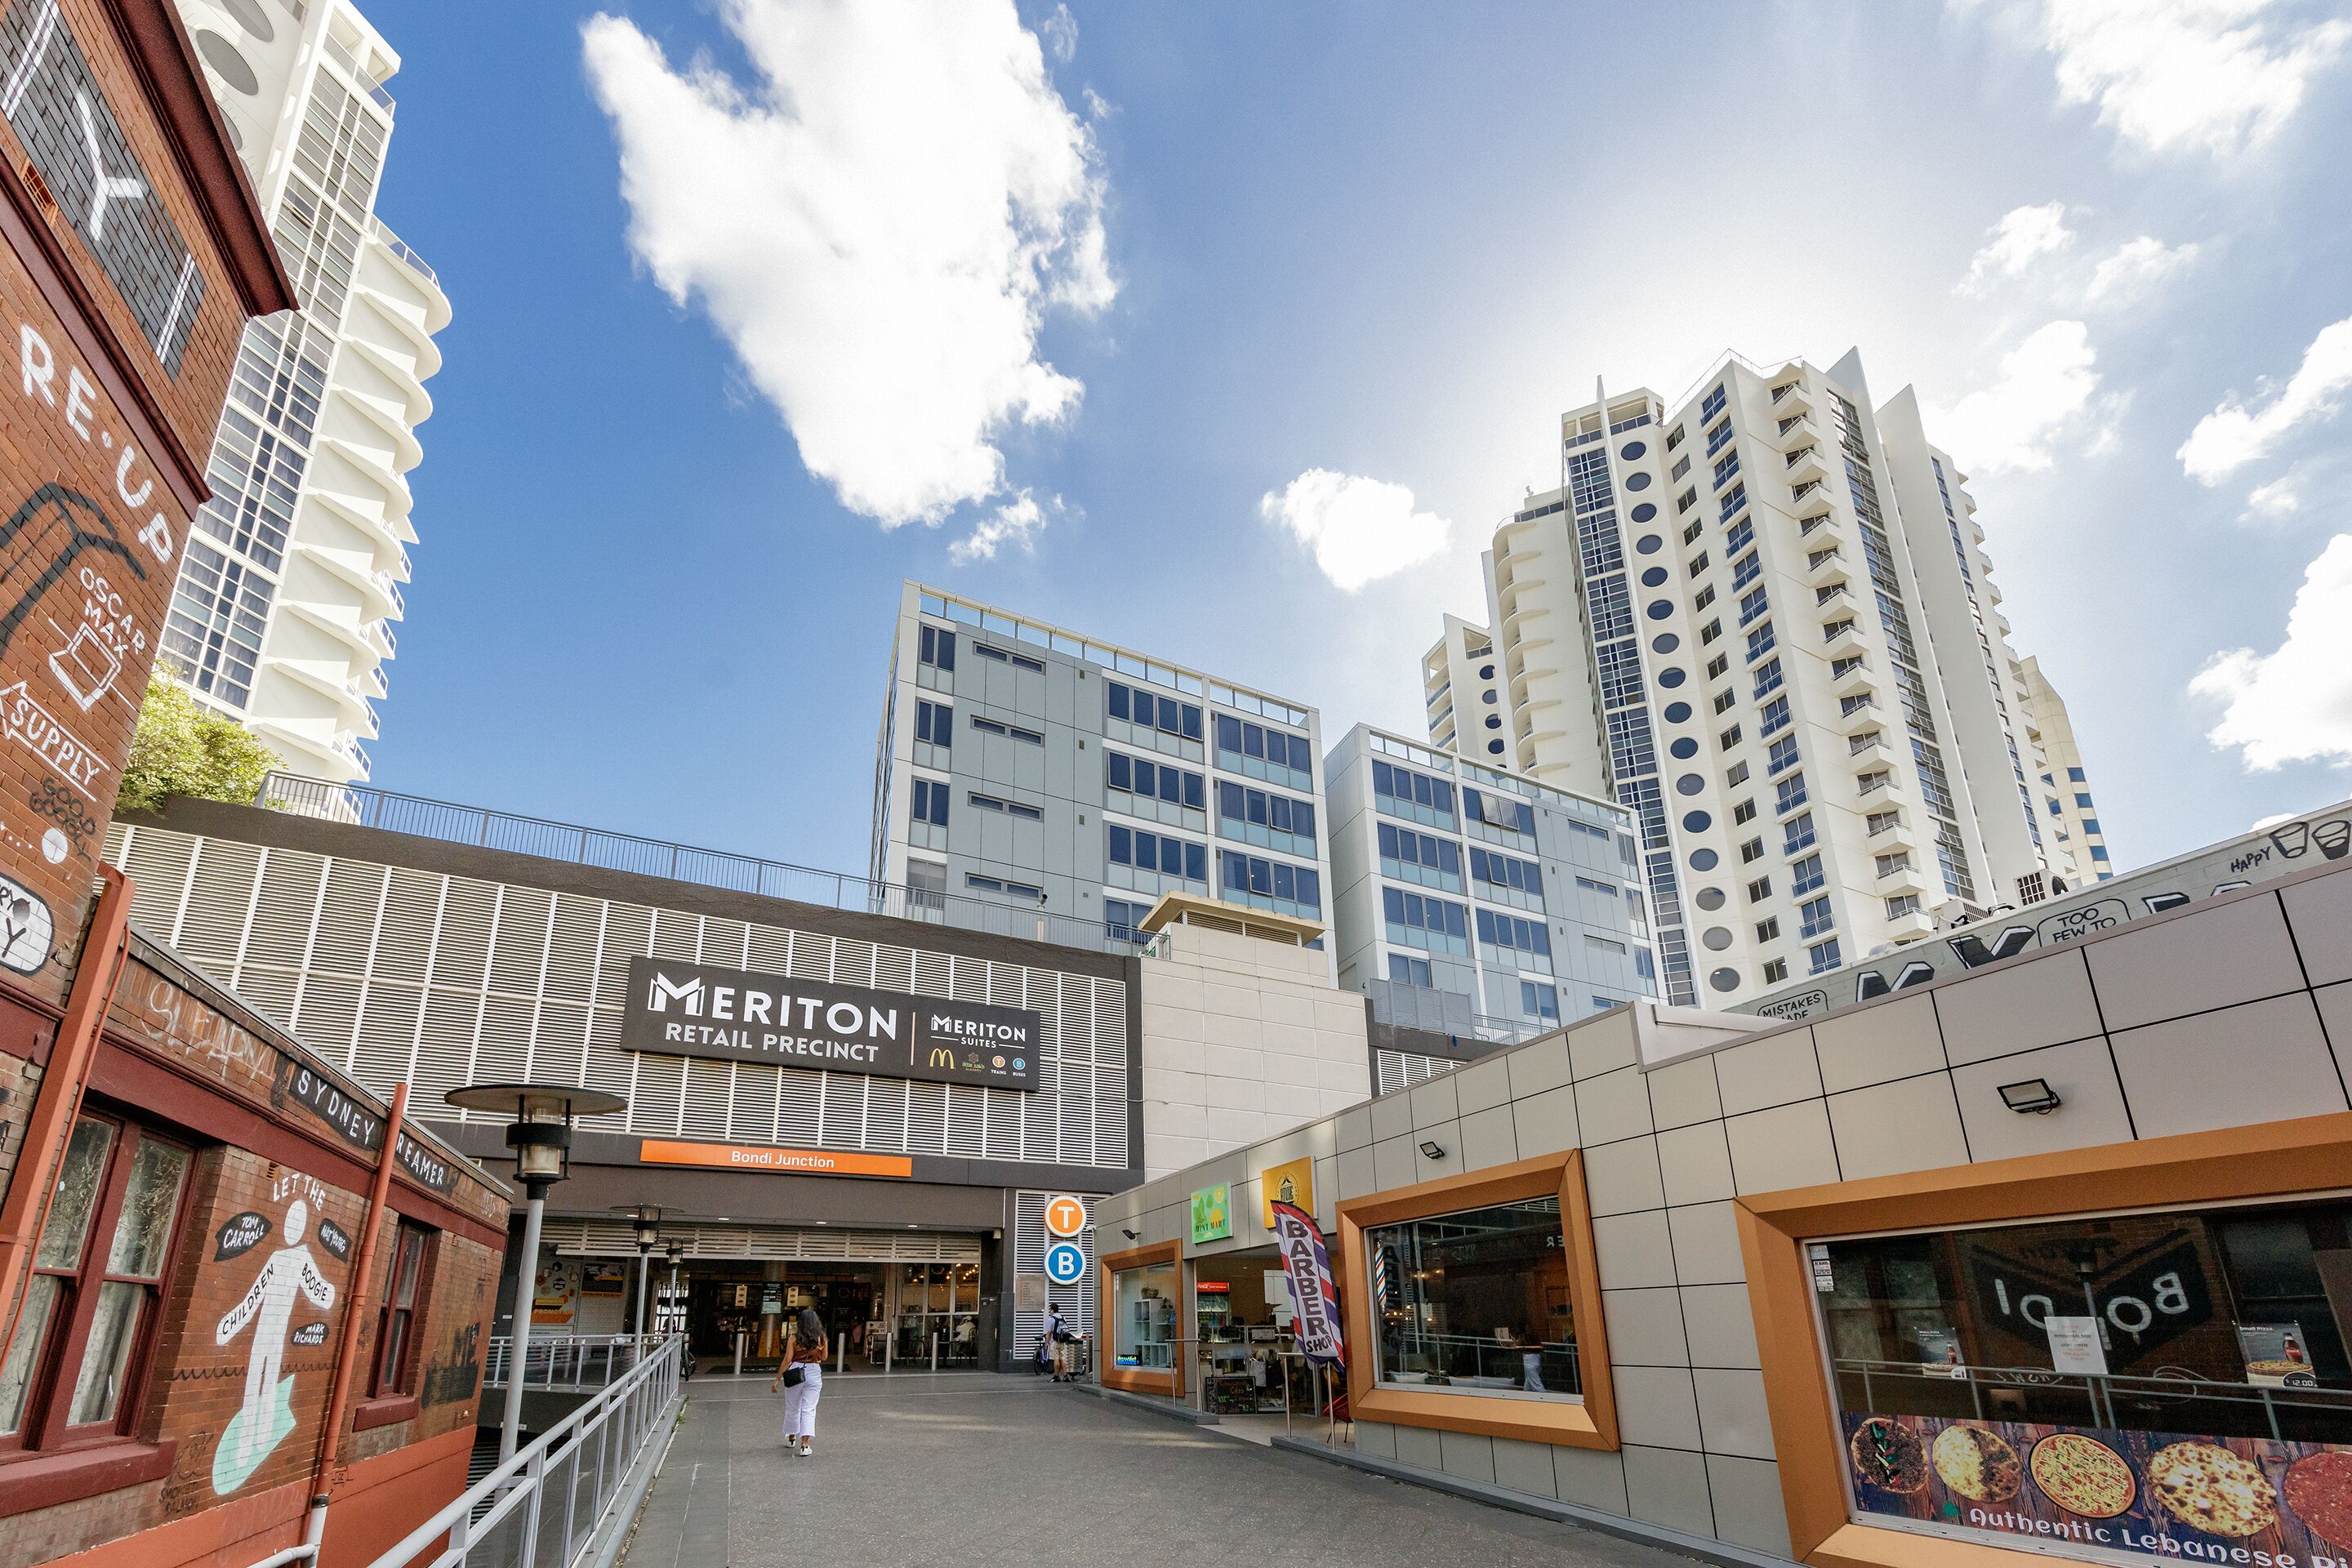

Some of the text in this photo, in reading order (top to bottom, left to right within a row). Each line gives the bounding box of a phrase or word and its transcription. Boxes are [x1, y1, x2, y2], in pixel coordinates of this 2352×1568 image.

[80, 566, 146, 656] OSCAR
[84, 597, 129, 660] MAX
[11, 698, 100, 786] SUPPLY
[2230, 845, 2271, 873] HAPPY
[2052, 916, 2116, 943] FEW TO
[2056, 907, 2100, 929] TOO
[648, 971, 898, 1040] MERITON
[1762, 993, 1821, 1018] MISTAKES
[1781, 1009, 1809, 1021] ADE
[931, 1013, 1026, 1042] MERITON
[665, 1022, 879, 1062] RETAIL PRECINCT
[960, 1036, 997, 1049] SUITES
[297, 1069, 376, 1146] SYDNEY
[396, 1132, 445, 1186] REAMER
[731, 1150, 835, 1169] Bondi Junction
[274, 1173, 327, 1212] LET THE
[241, 1215, 260, 1229] TOM
[1057, 1205, 1076, 1229] T
[223, 1224, 265, 1250] CARROLL
[1058, 1252, 1076, 1276] B
[301, 1262, 328, 1302] BOOGIE
[1285, 1220, 1330, 1337] BARBER
[221, 1263, 275, 1336] CHILDREN
[293, 1330, 324, 1344] RICHARDS
[305, 1321, 326, 1334] MARK
[1306, 1334, 1334, 1353] SHOP
[1970, 1508, 2112, 1543] Authentic
[2123, 1528, 2297, 1568] Lebanese
